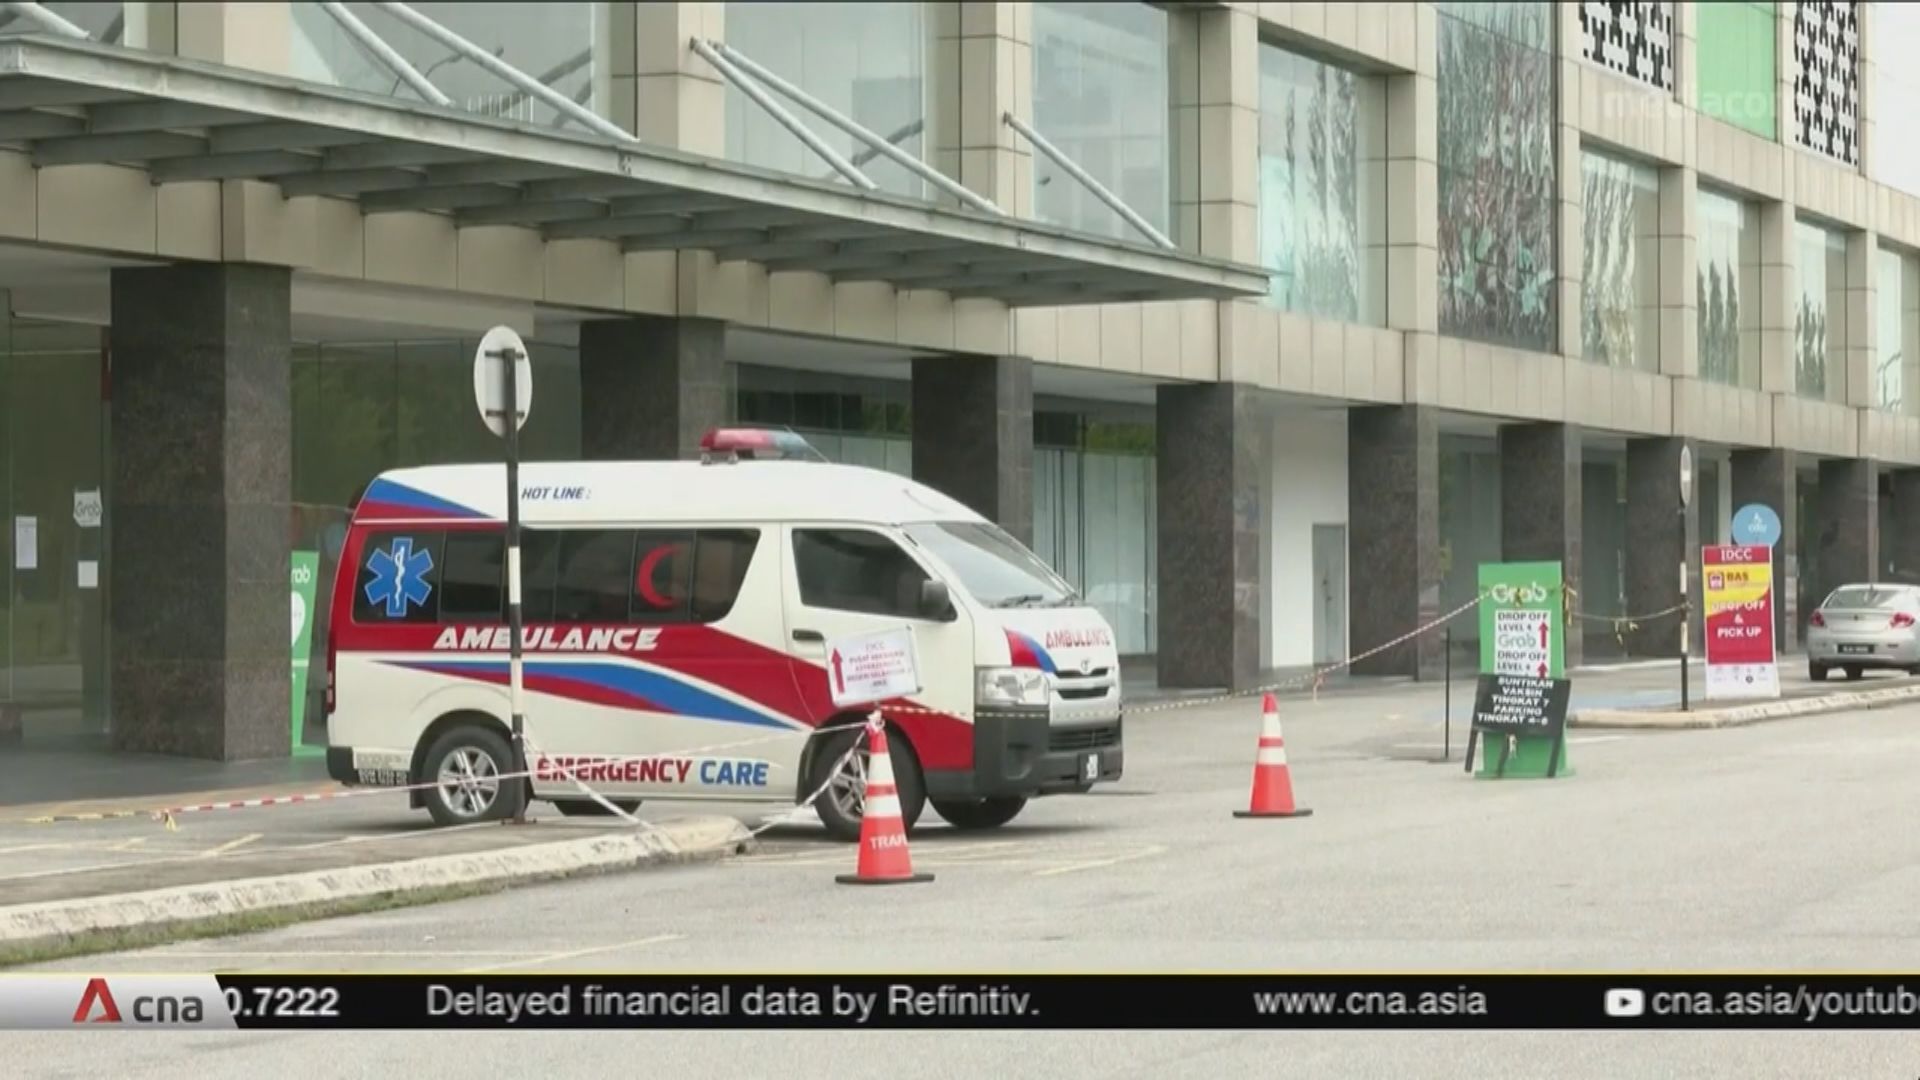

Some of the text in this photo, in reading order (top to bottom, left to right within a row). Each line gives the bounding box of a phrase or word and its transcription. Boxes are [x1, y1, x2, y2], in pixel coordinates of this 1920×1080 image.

[521, 486, 552, 499] HOT
[552, 486, 584, 499] LINE
[1721, 547, 1752, 562] IDCC
[291, 563, 311, 584] rab
[1727, 571, 1749, 582] BAS
[1492, 581, 1547, 603] Grab
[1744, 600, 1766, 611] OFF
[1498, 612, 1548, 621] DROP OFF
[1498, 624, 1524, 632] LEVEL
[1717, 625, 1762, 638] PICK UP
[434, 627, 663, 650] AMBULANCE
[1498, 633, 1537, 649] Grab
[1497, 651, 1547, 662] DROP OFF
[1497, 662, 1523, 671] LEVEL
[1502, 686, 1543, 698] VAKSIN
[1491, 694, 1540, 707] TINGKAT
[1477, 711, 1525, 724] TINGKAT
[1493, 705, 1542, 717] PARKING
[536, 757, 769, 786] EMERGENCY CARE
